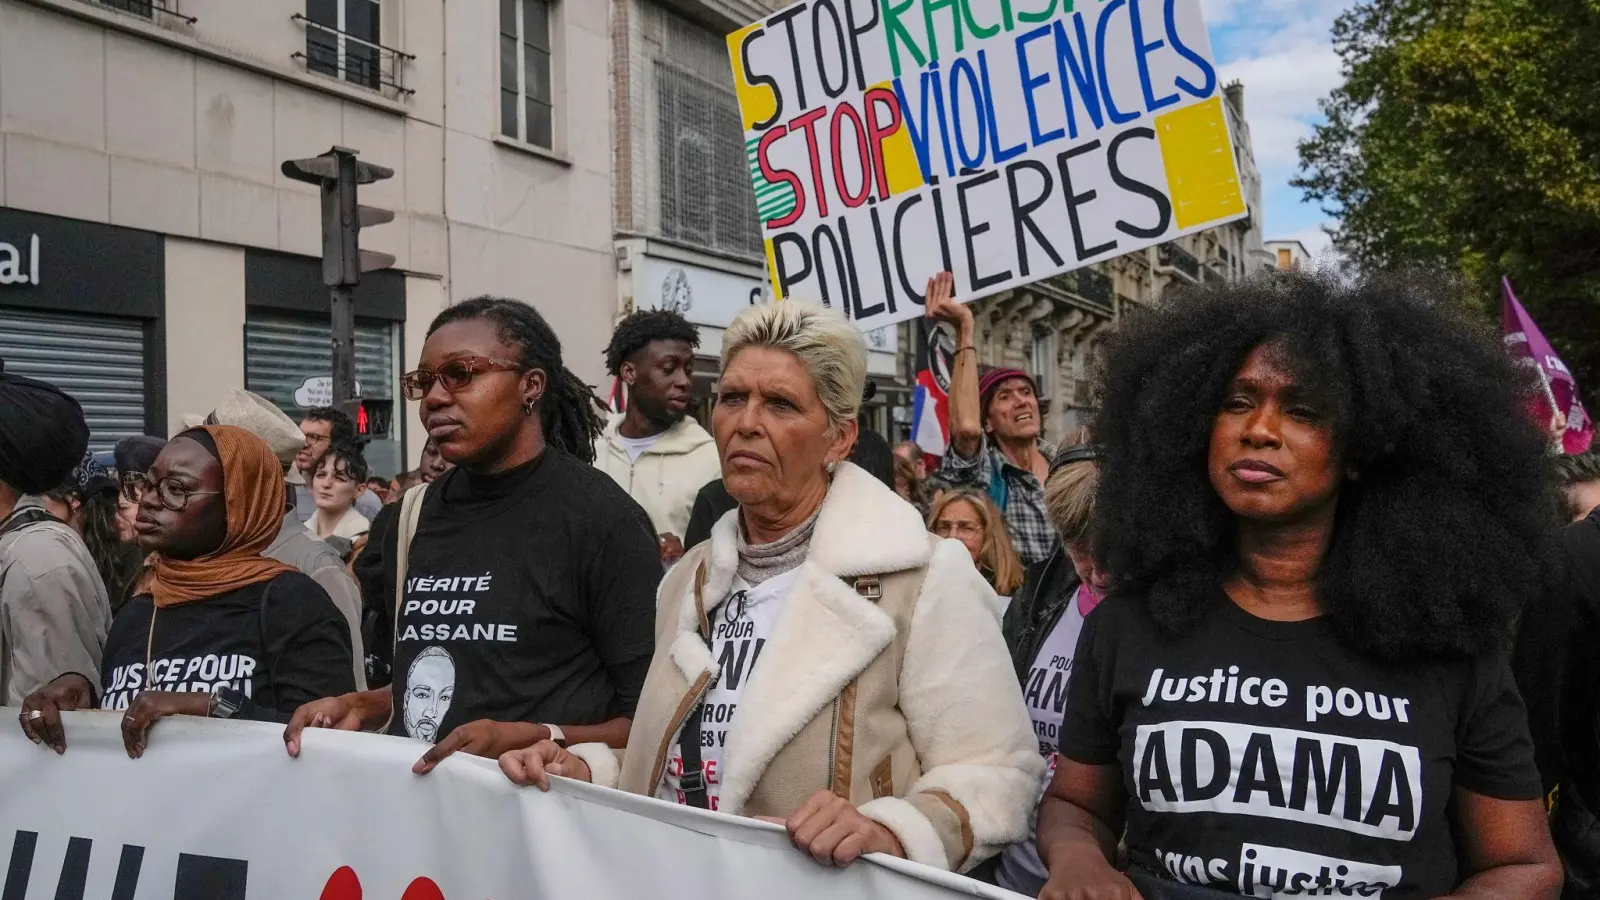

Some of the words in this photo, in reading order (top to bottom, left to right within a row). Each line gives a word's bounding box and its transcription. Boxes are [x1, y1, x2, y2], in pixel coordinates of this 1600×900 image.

[741, 0, 879, 131] STOP
[758, 88, 902, 229] STOP
[892, 0, 1217, 185] VIOLENCES
[772, 127, 1171, 320] POLICIÈRES
[0, 233, 40, 285] al
[404, 600, 476, 616] POUR
[407, 571, 492, 594] VÉRITÉ
[716, 620, 754, 640] POUR
[106, 658, 185, 694] JUSICE
[184, 653, 257, 686] POUR
[1141, 665, 1288, 707] Justice
[1306, 685, 1410, 722] pour
[1139, 727, 1415, 832] ADAMA
